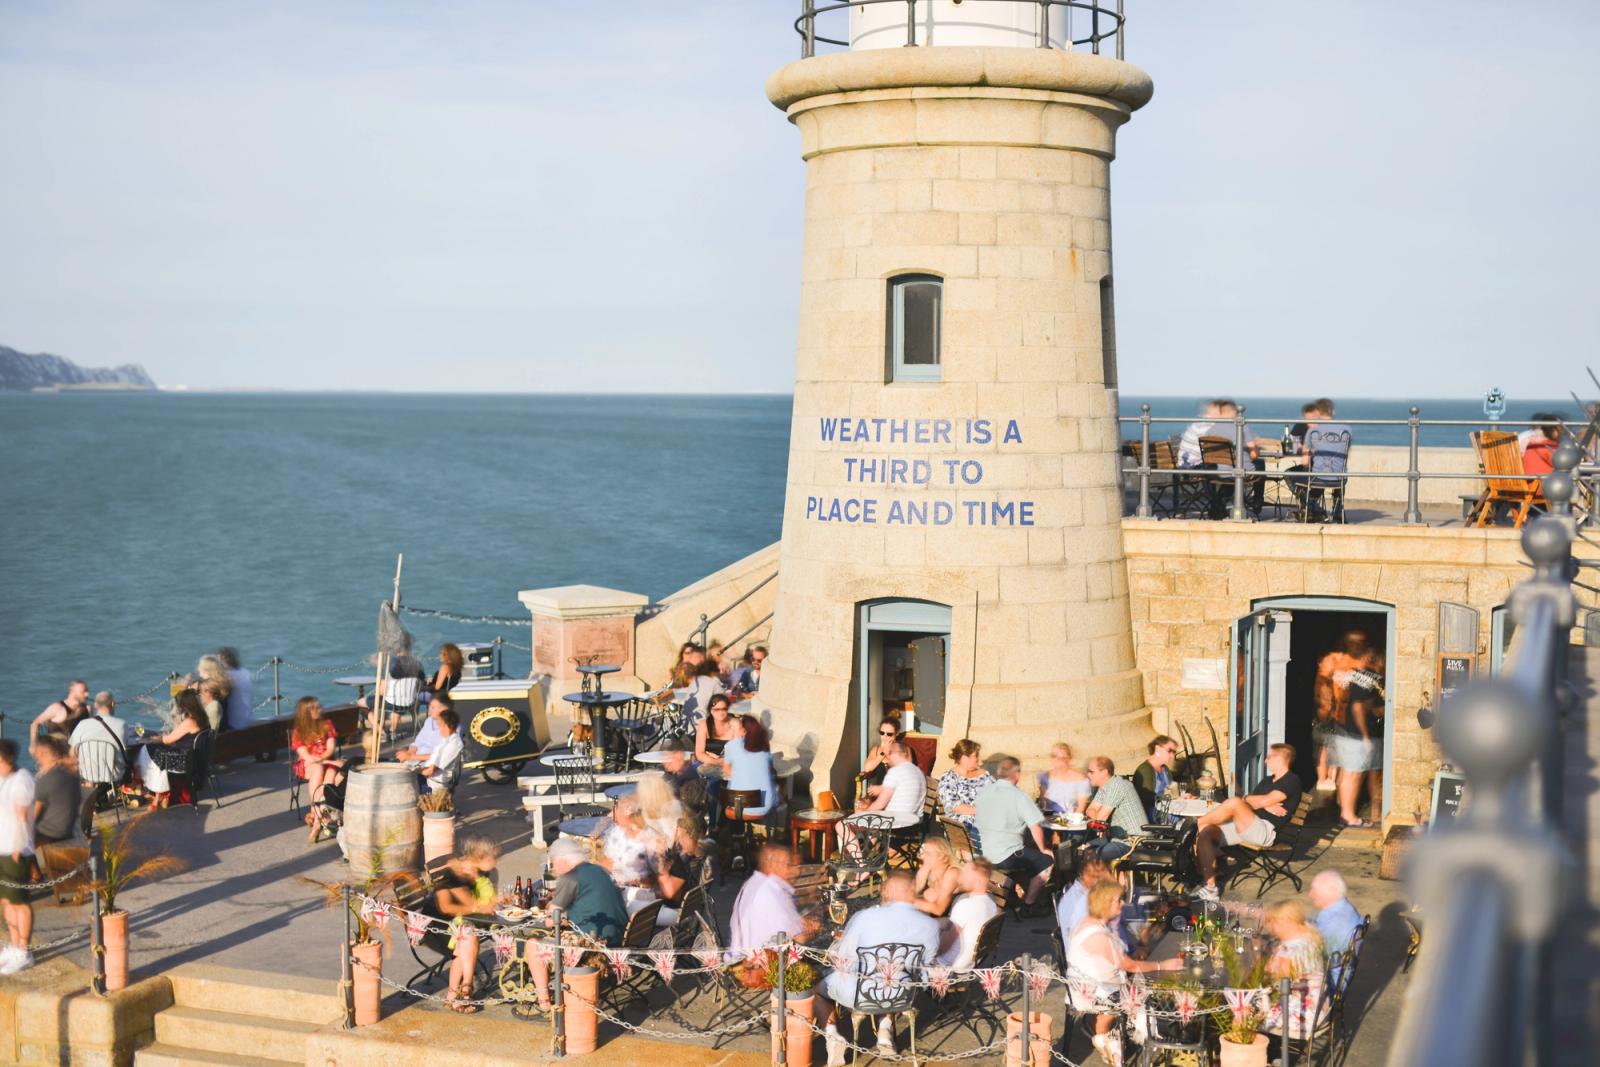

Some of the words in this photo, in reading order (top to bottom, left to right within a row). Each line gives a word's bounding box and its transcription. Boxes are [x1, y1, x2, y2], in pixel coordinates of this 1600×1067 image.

[820, 417, 952, 444] WEATHER
[965, 419, 992, 444] IS
[1003, 419, 1023, 444] A
[843, 457, 932, 485] THIRD
[943, 460, 983, 485] TO
[806, 496, 878, 524] PLACE
[887, 500, 953, 526] AND
[962, 501, 1035, 526] TIME
[1447, 659, 1463, 667] LIVE
